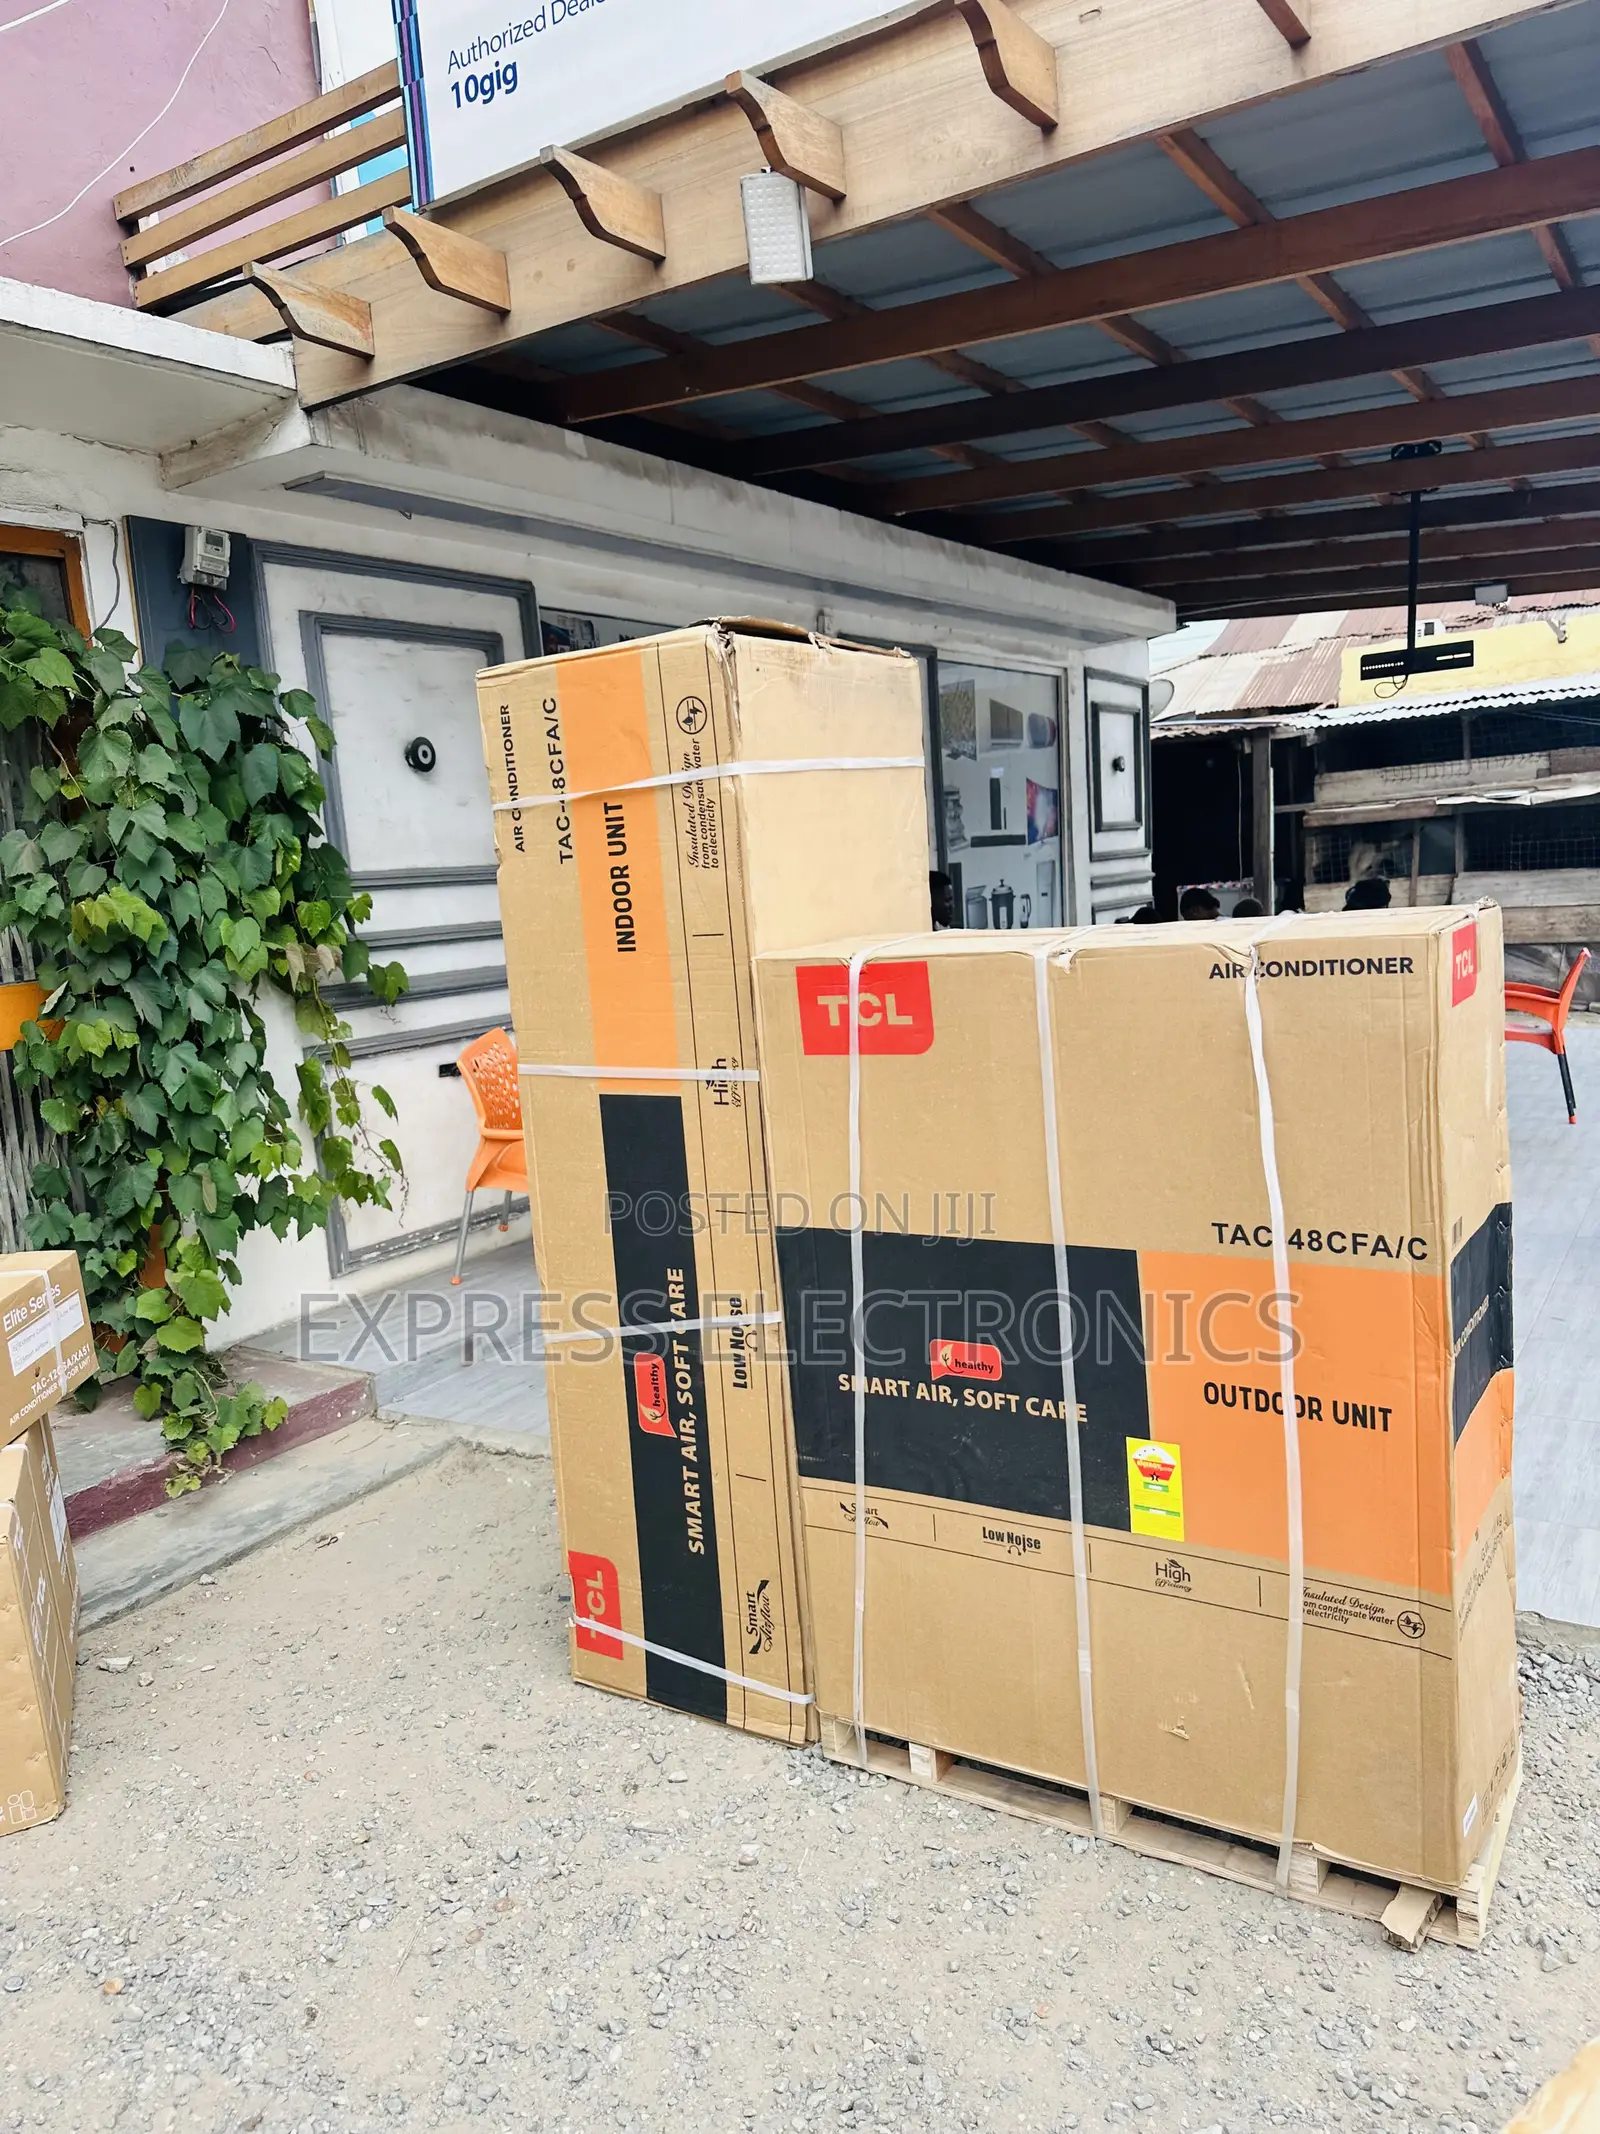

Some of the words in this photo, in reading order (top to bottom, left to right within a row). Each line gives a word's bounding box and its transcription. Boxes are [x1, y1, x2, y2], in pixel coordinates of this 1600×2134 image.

[448, 5, 547, 74] Authorized
[551, 0, 606, 25] Dea
[451, 60, 518, 108] 10gig
[682, 751, 695, 800] Deign
[603, 802, 628, 857] UNIT
[687, 803, 700, 868] Insulated
[696, 778, 710, 848] condensat
[705, 798, 718, 856] electricity
[514, 825, 525, 852] AIR
[701, 848, 711, 870] from
[711, 858, 719, 869] to
[610, 864, 637, 952] INDOOR
[1209, 962, 1245, 979] AIR
[1455, 949, 1474, 980] TCL
[817, 992, 914, 1026] TCL
[711, 1058, 731, 1106] Hih
[1211, 1222, 1428, 1261] TAC48CFA/C
[2, 1305, 29, 1333] Elite
[28, 1283, 61, 1314] Seres
[730, 1297, 746, 1350] Nose
[650, 1362, 661, 1408] healthy
[672, 1339, 694, 1406] SOFT
[954, 1357, 994, 1375] healthy
[838, 1373, 911, 1398] SMART
[916, 1382, 959, 1407] AIR,
[963, 1388, 1020, 1413] SOFT
[1203, 1381, 1323, 1422] OUTDOOR
[1332, 1400, 1393, 1432] UNIT
[679, 1411, 698, 1463] AIR,
[682, 1465, 705, 1555] SMART
[850, 1502, 878, 1516] Sart
[1006, 1531, 1041, 1552] Noise
[1155, 1561, 1191, 1583] High
[746, 1590, 758, 1637] Smart
[1303, 1600, 1317, 1609] om
[1318, 1602, 1367, 1620] condensate
[1369, 1613, 1395, 1626] water
[1306, 1608, 1350, 1626] electricity
[1349, 1596, 1385, 1615] Design
